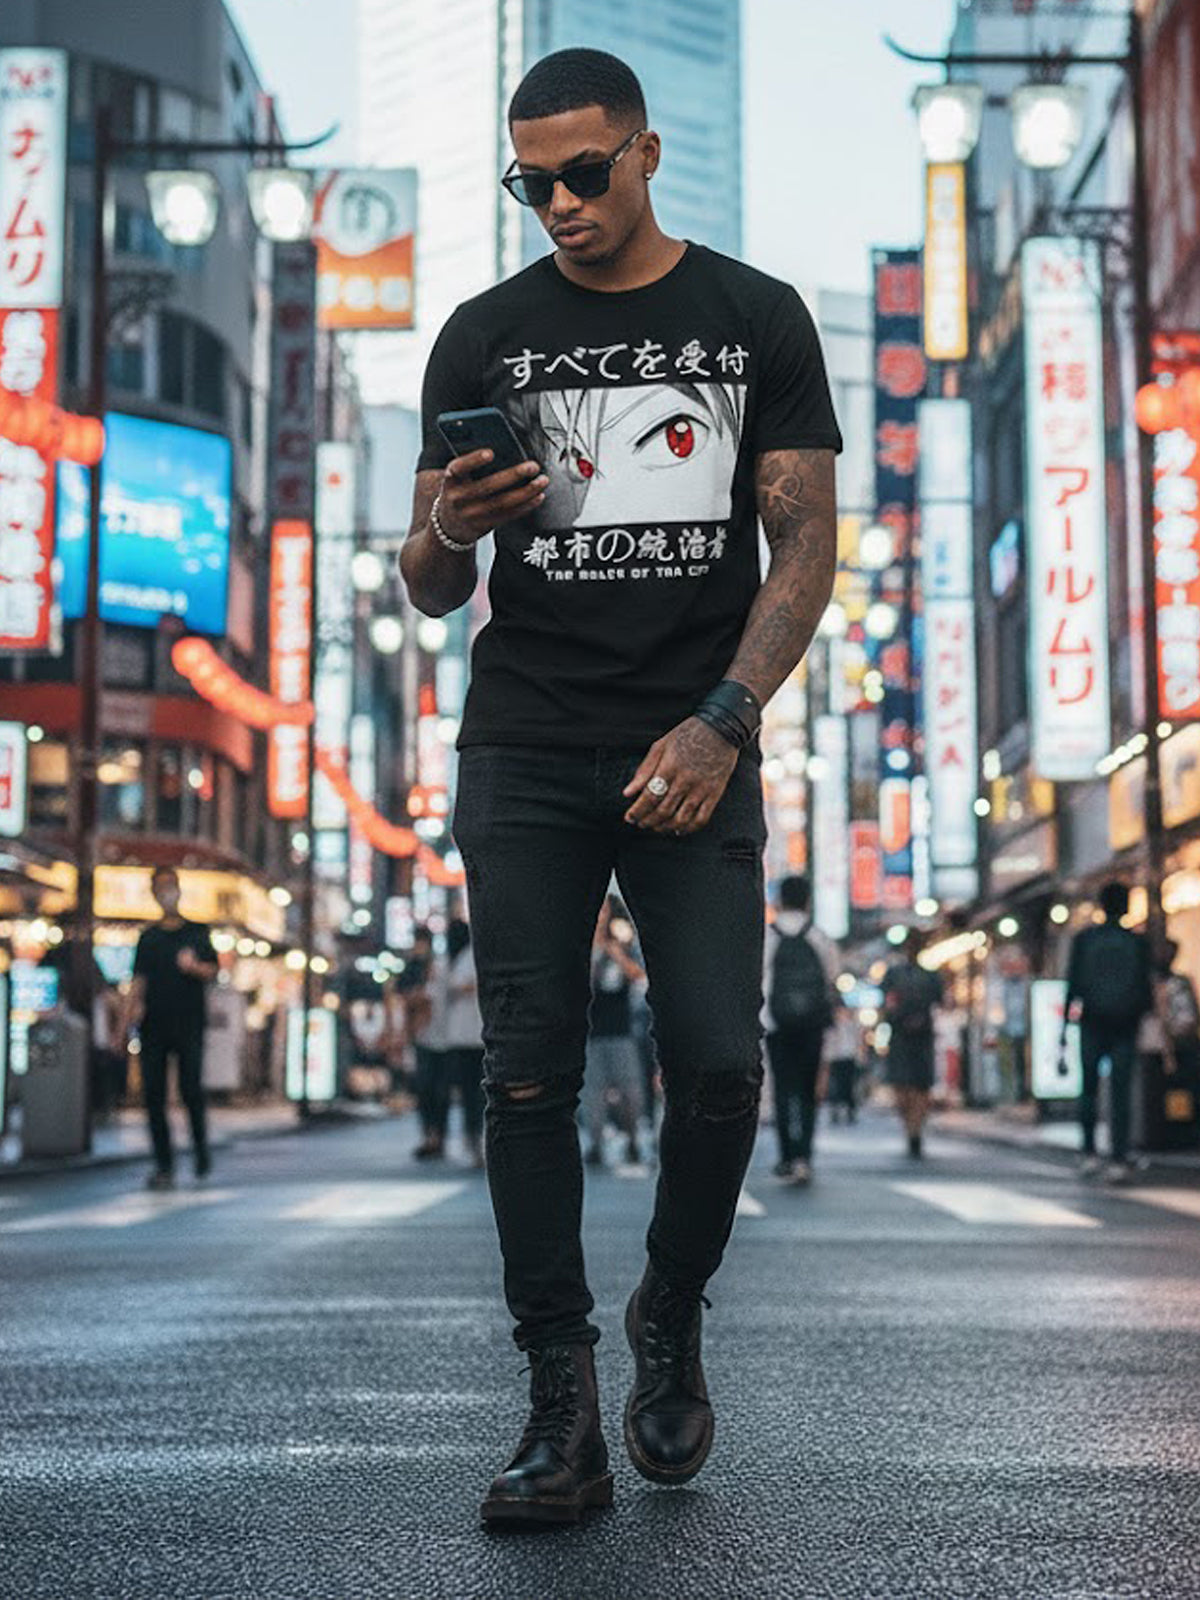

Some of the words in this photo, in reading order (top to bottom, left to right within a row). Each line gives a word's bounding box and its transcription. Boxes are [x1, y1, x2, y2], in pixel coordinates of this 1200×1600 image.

[503, 339, 749, 389] すべてを受付
